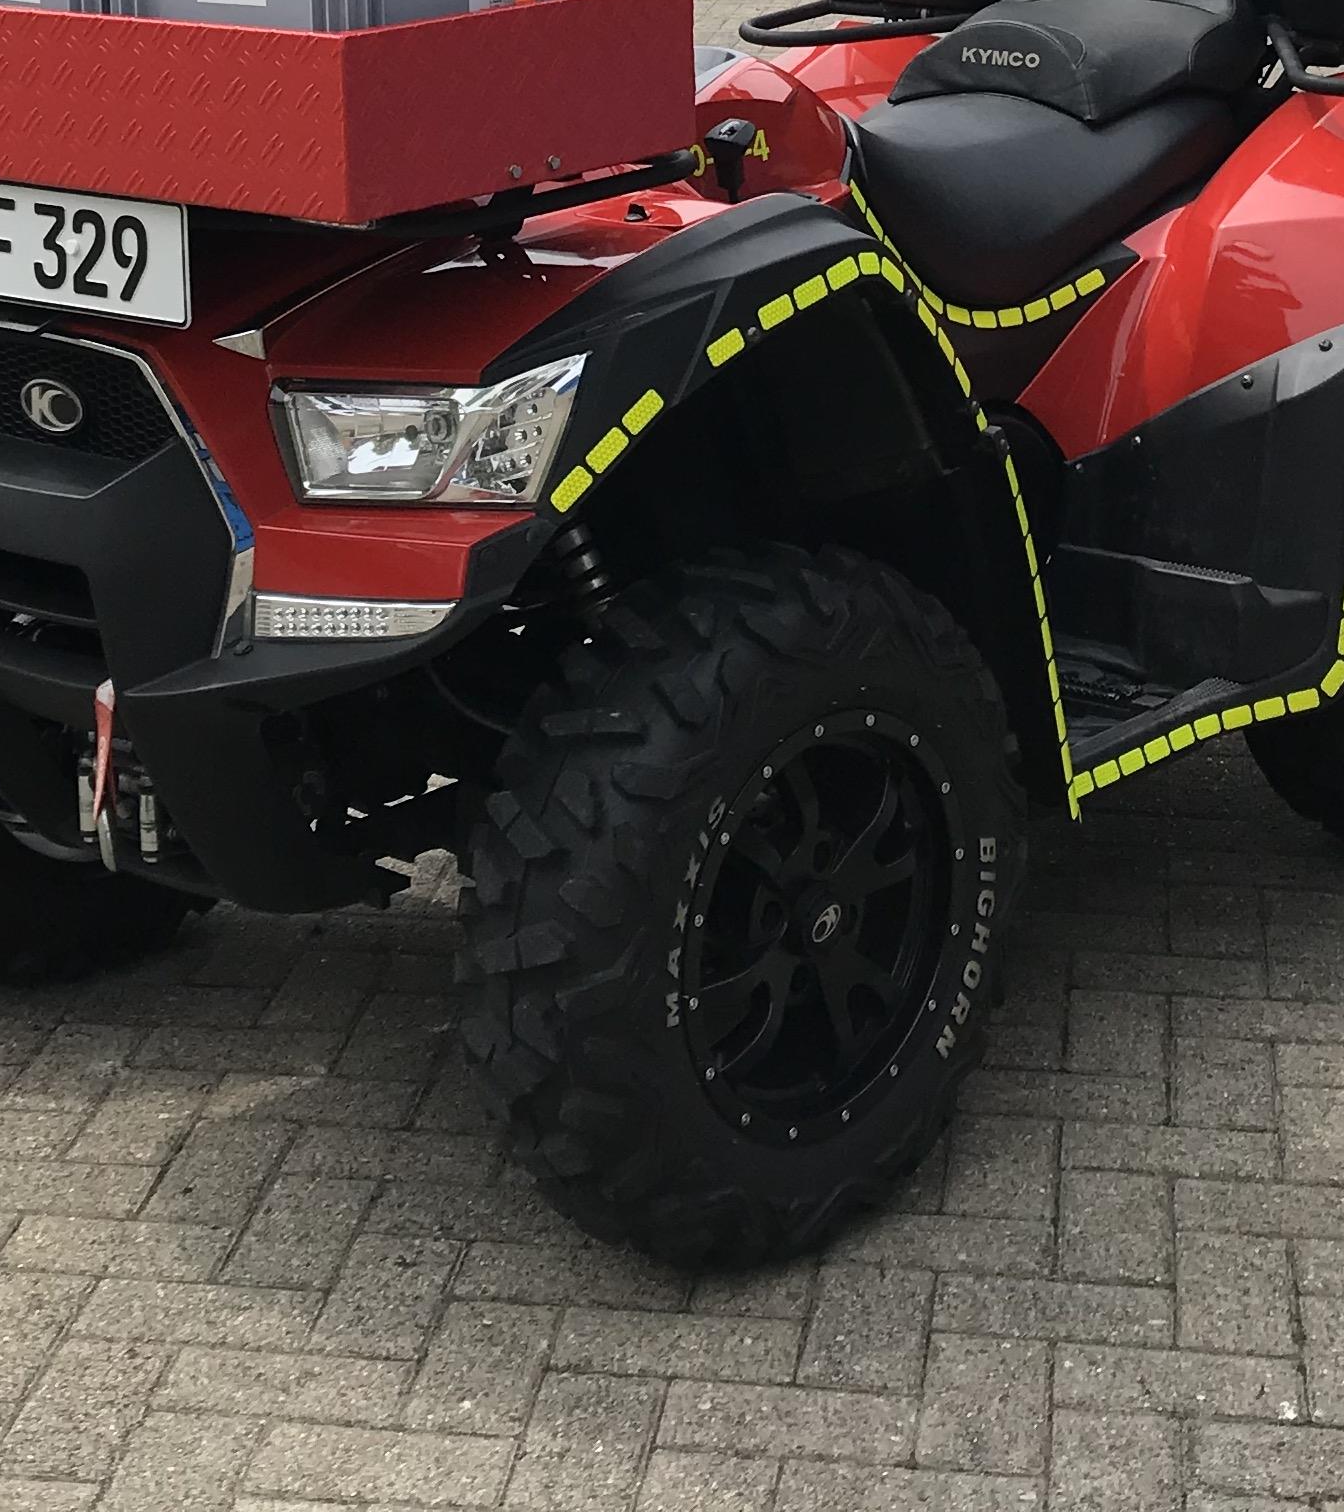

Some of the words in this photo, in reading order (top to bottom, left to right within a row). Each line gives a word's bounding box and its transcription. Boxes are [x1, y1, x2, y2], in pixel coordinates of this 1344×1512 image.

[960, 46, 1041, 68] KYMCO
[33, 202, 149, 302] 329
[664, 794, 727, 1028] MAXXIS
[934, 836, 997, 1060] BIGHORN
